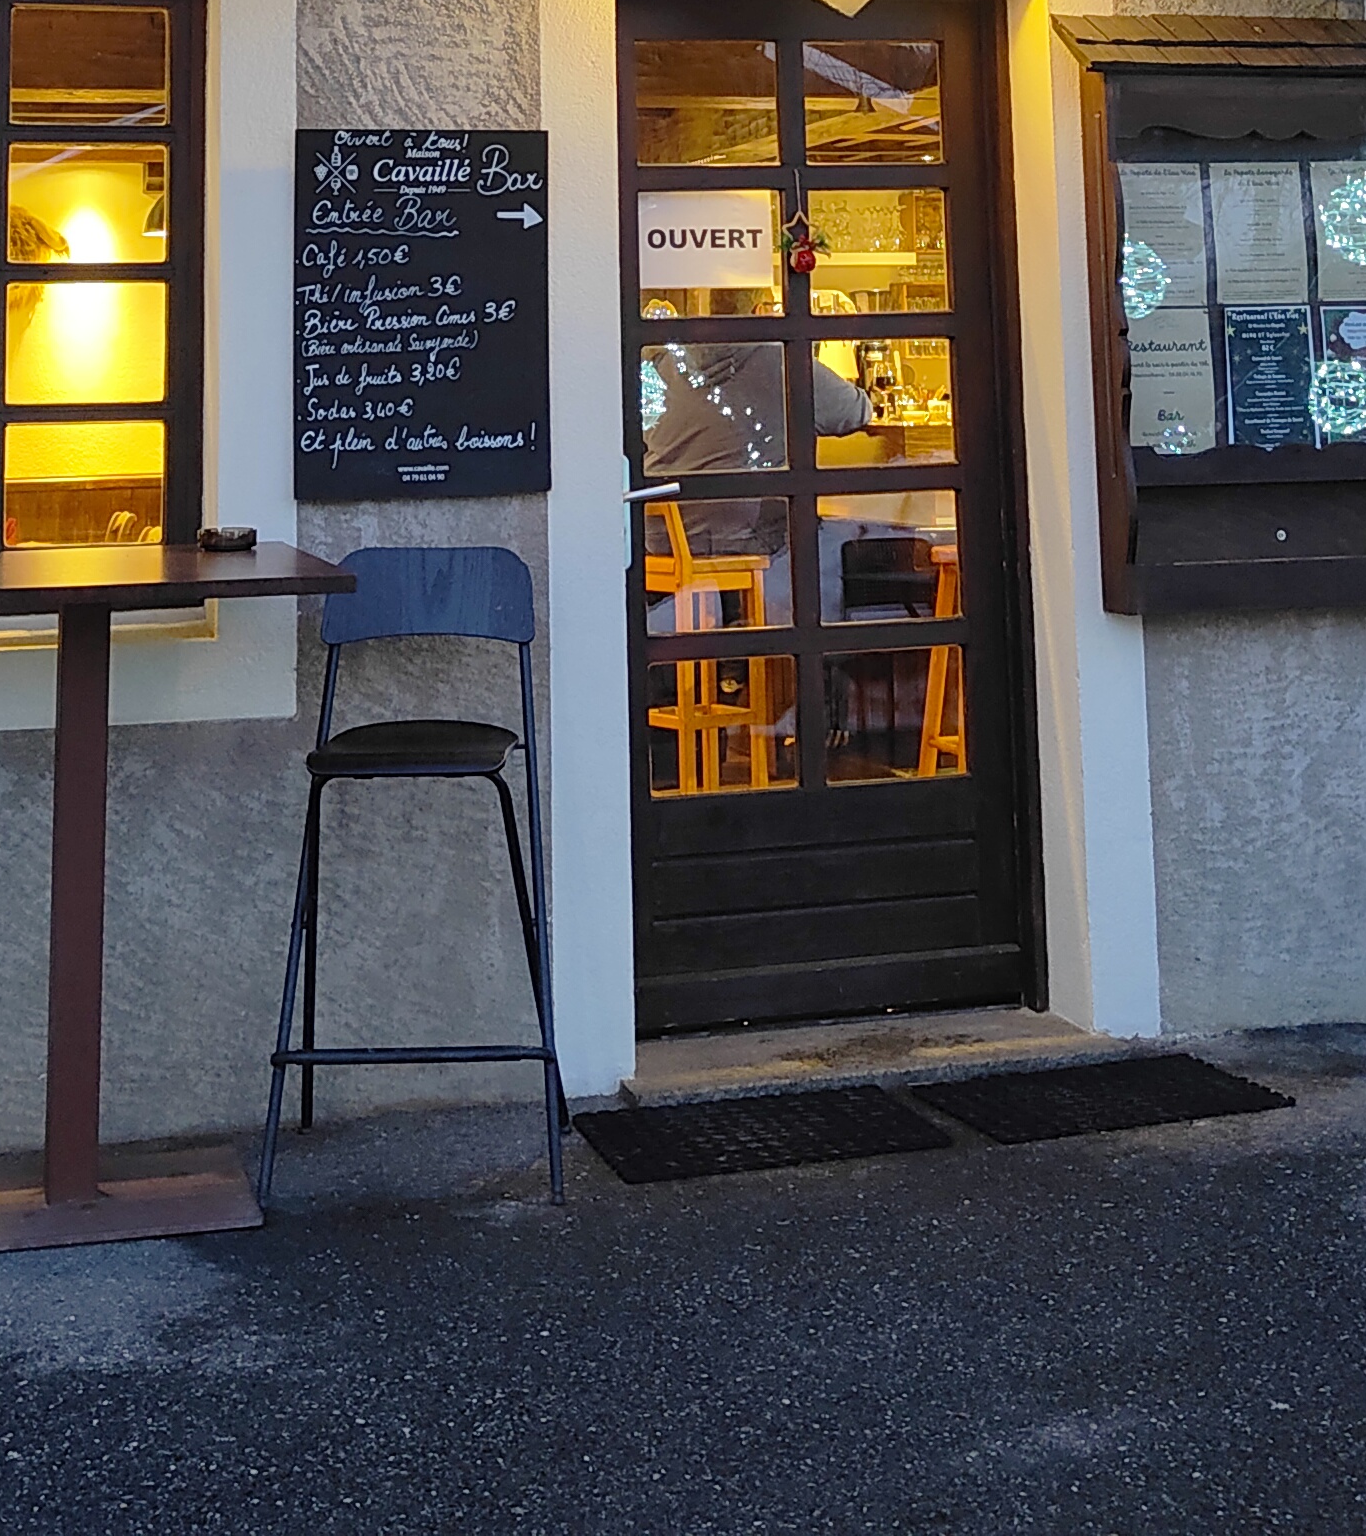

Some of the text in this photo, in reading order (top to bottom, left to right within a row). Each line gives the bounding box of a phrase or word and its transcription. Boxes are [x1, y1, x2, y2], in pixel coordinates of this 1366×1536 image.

[334, 130, 469, 153] Ouvert à tous!
[405, 149, 440, 158] Maison
[373, 159, 471, 182] Cavaillé
[477, 144, 543, 195] Bar
[399, 185, 447, 194] Depuis 1949
[312, 195, 457, 230] Entrée Bar
[647, 228, 763, 249] OUVERT
[302, 240, 409, 278] Café 1,50€
[427, 275, 462, 297] 3€
[303, 309, 358, 338] Bière
[364, 306, 431, 330] Pression
[483, 300, 516, 323] 3€
[1129, 339, 1207, 352] Restaurant
[303, 357, 461, 396] Jus de fruits 3,20€
[307, 397, 414, 421] Sodas 3,40€
[1157, 409, 1185, 421] Bar
[300, 428, 326, 452] Et
[329, 427, 375, 470] plein
[385, 424, 447, 451] d'autres
